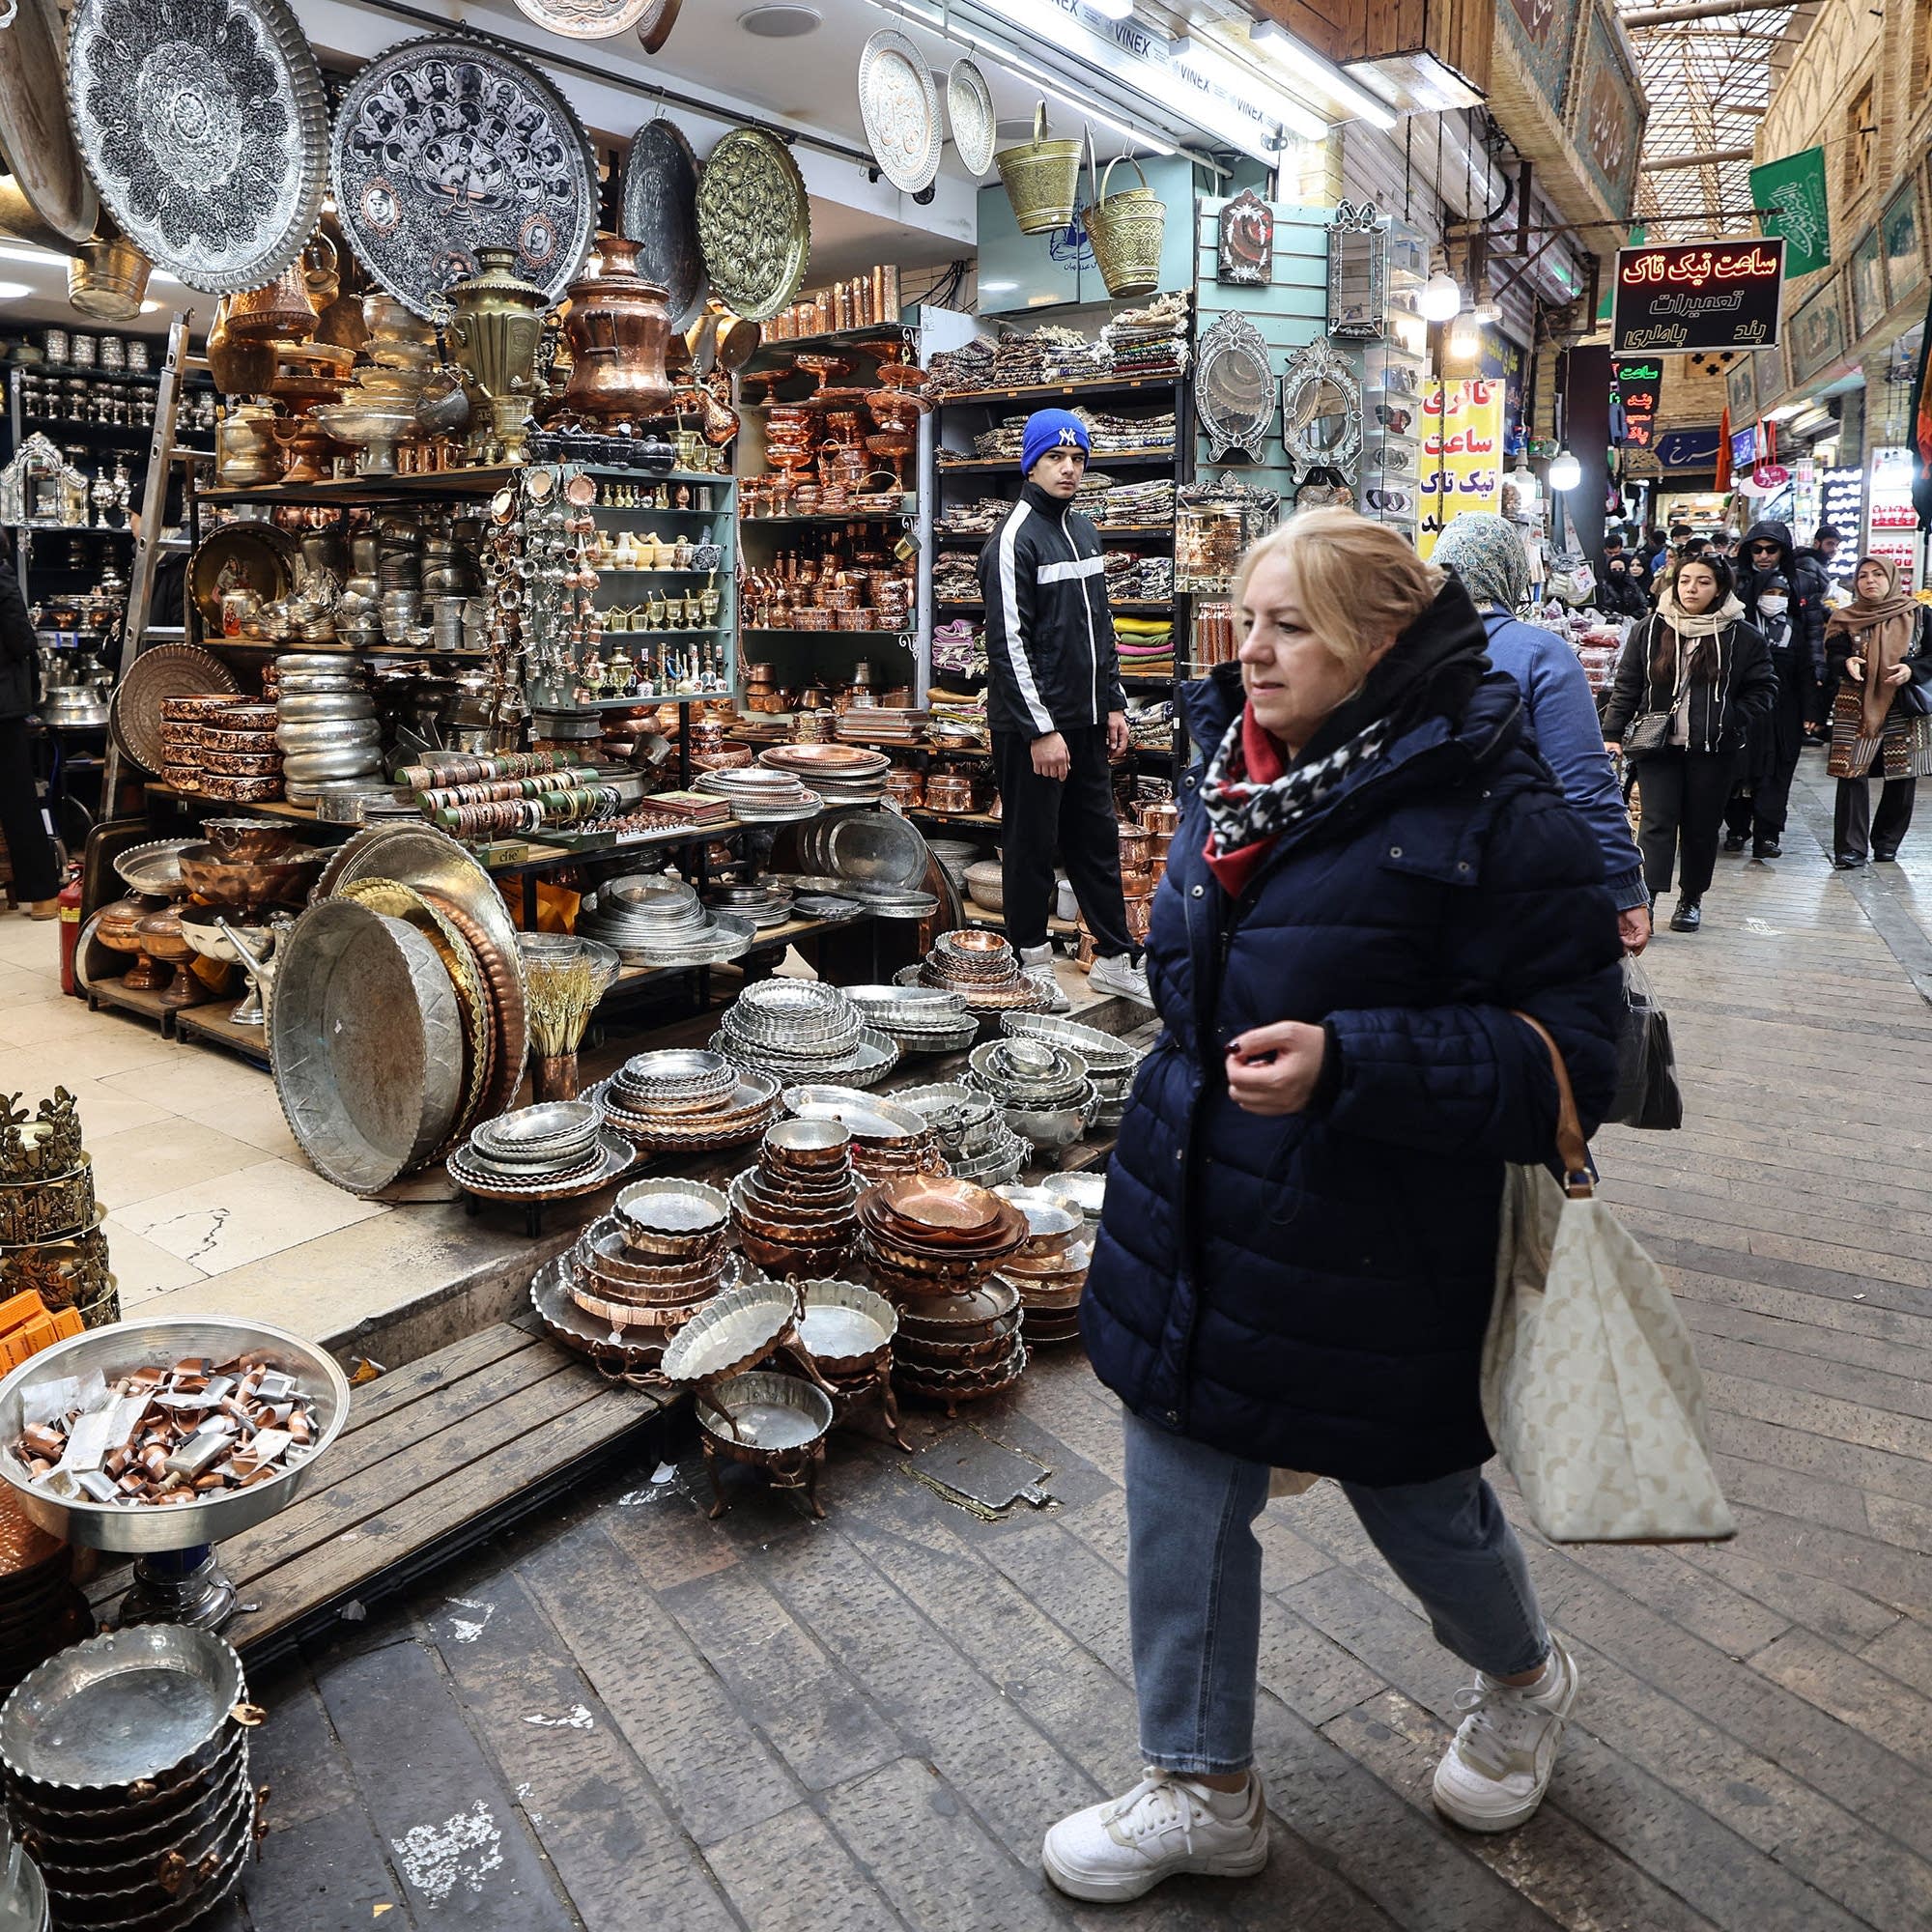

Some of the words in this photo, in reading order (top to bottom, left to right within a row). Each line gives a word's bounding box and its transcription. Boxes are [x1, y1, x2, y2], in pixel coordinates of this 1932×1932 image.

[1115, 23, 1151, 58] VINEX
[1180, 64, 1210, 94] VINEX
[1237, 98, 1264, 124] VINEX
[1623, 254, 1666, 283] تاک
[1668, 252, 1713, 286] تیک
[1715, 247, 1777, 278] ساعت
[1649, 290, 1745, 318] تعمیرات
[1624, 323, 1689, 350] باطری
[1733, 320, 1767, 344] بند
[1620, 365, 1659, 380] ساعت
[1423, 380, 1496, 415] گالری
[1059, 428, 1077, 446] NY
[1424, 428, 1492, 455] ساعت
[1421, 470, 1455, 494] تاک
[1460, 470, 1495, 498] تیک
